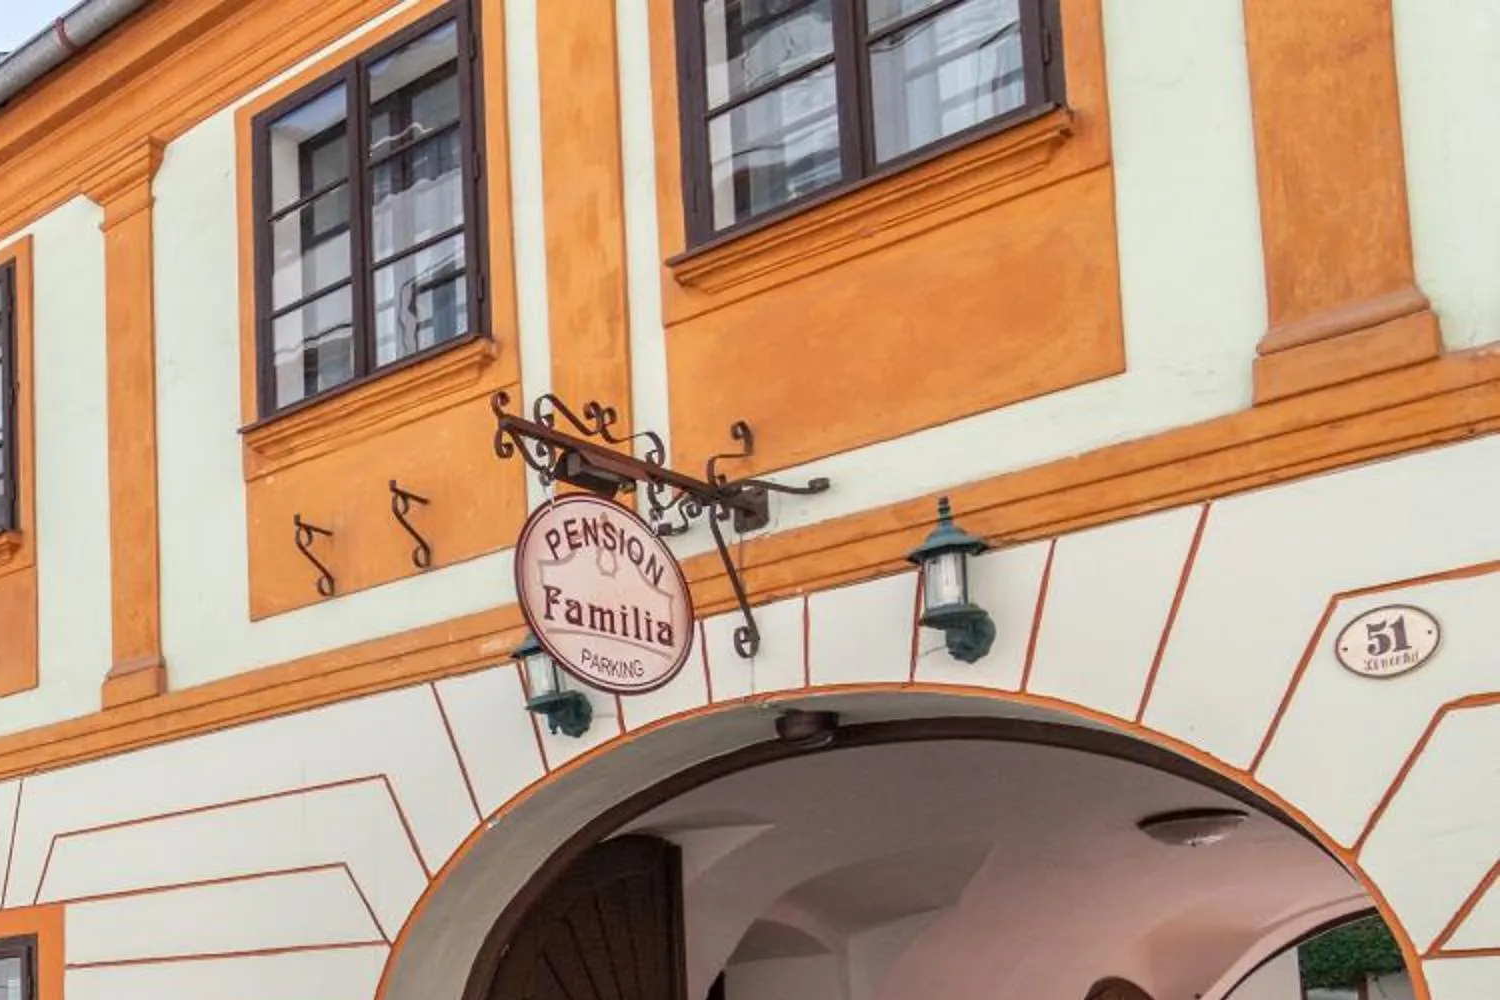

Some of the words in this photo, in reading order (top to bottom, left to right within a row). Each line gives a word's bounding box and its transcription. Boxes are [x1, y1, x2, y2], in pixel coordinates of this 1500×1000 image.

[545, 517, 664, 587] PENSION
[542, 585, 674, 647] Familia
[1366, 614, 1412, 656] 51
[581, 648, 645, 678] PARKING
